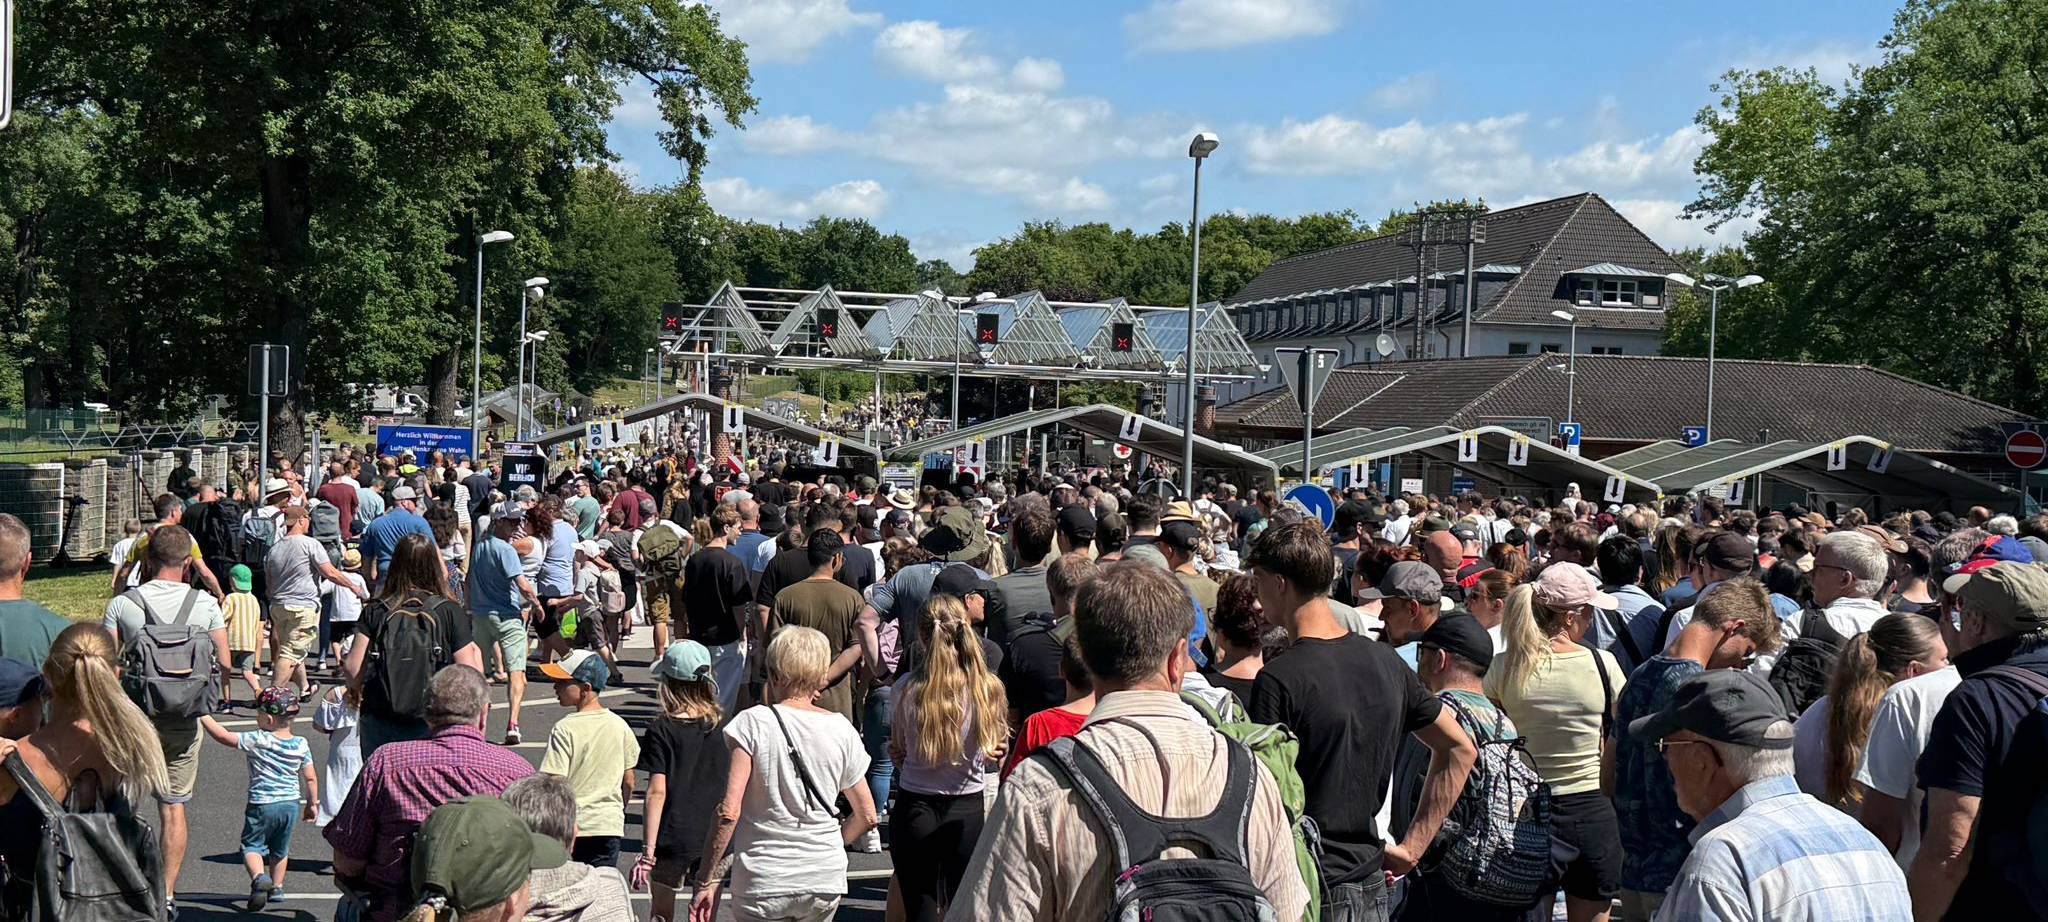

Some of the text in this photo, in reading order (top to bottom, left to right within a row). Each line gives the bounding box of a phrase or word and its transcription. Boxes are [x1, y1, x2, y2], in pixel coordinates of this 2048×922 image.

[423, 432, 461, 440] Willkommen
[1564, 426, 1575, 438] P
[390, 445, 447, 453] Luftwaffenkane
[515, 463, 531, 474] VIP
